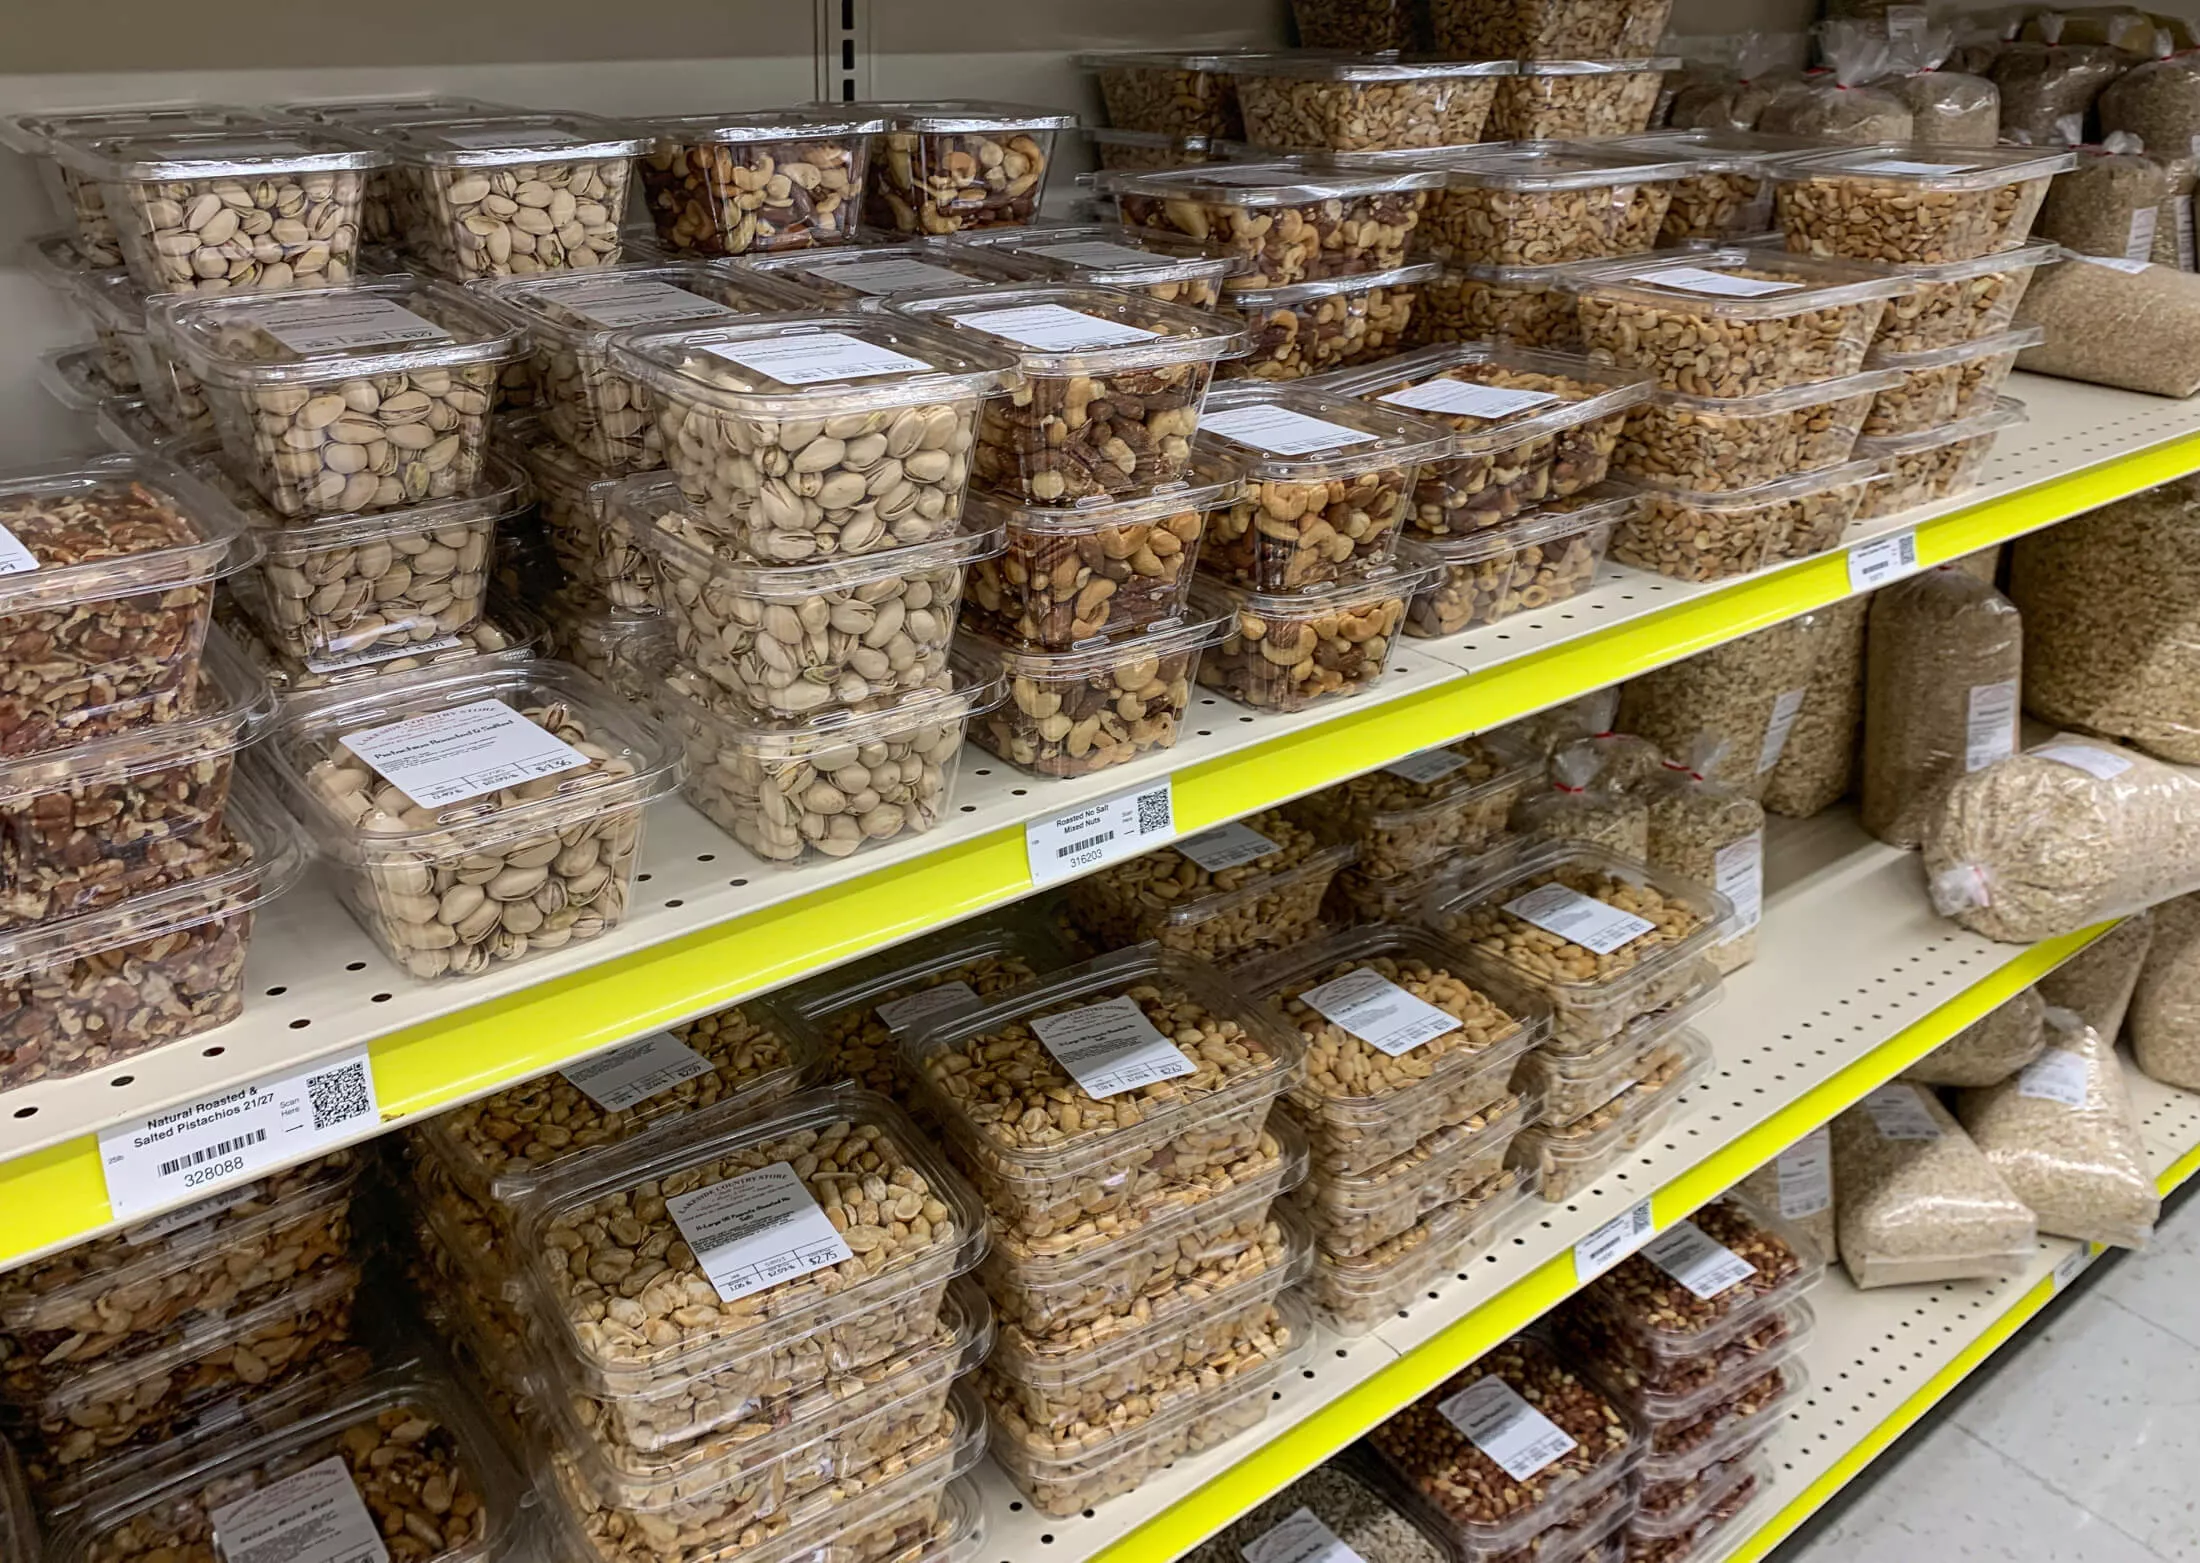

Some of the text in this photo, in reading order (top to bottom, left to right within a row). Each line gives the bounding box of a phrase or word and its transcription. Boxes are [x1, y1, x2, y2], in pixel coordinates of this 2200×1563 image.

[482, 719, 514, 733] Salted
[1056, 804, 1109, 828] Roasted No Salt
[1064, 817, 1101, 834] Mixed Nuts
[1070, 849, 1103, 868] 316203
[147, 1086, 258, 1130] Natural Roasted &
[279, 1097, 300, 1110] Scan
[281, 1105, 301, 1117] Here
[133, 1093, 275, 1148] Salted Pistachios 21/27
[184, 1156, 244, 1188] 328088
[677, 1188, 716, 1215] LAKESIDE
[716, 1175, 757, 1191] COUNTRY
[757, 1173, 788, 1181] STORE
[808, 1251, 838, 1266] $2.75
